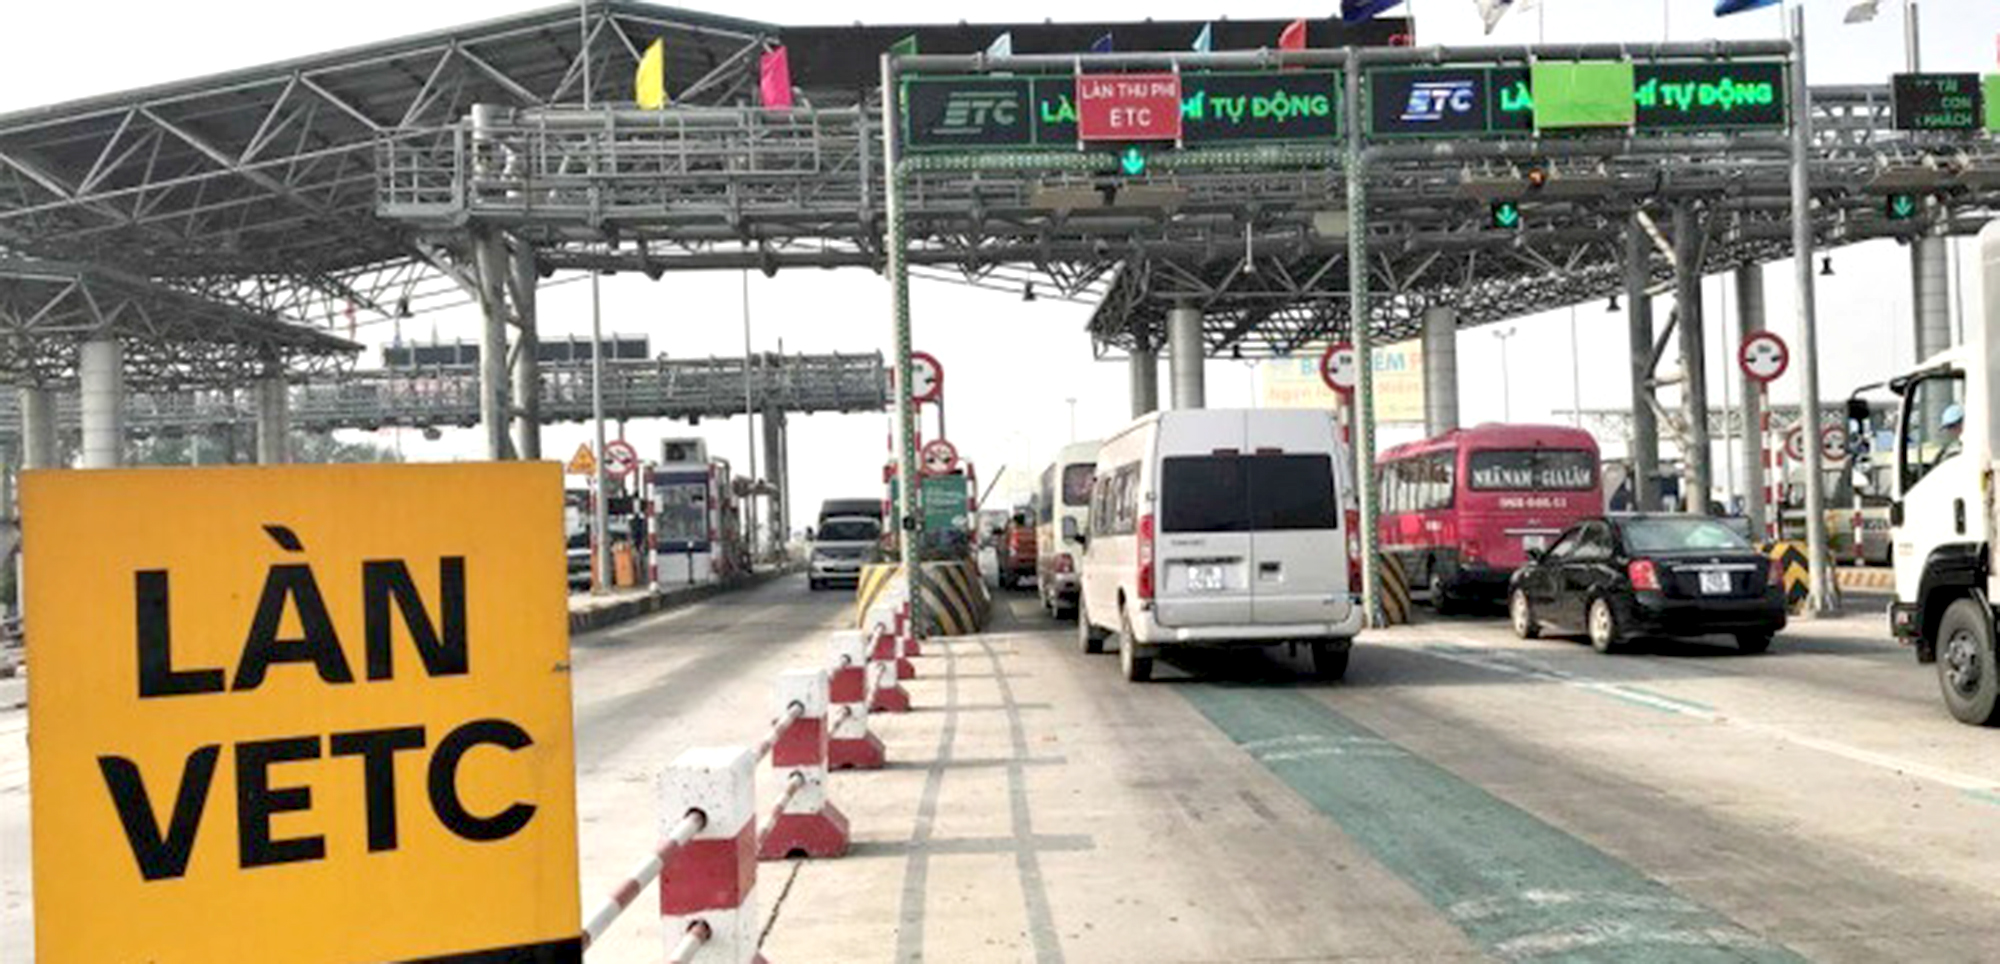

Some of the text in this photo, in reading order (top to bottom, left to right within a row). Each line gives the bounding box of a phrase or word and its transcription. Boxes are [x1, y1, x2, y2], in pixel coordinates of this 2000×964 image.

[1081, 80, 1114, 99] LÀN
[1116, 82, 1149, 99] THU
[1405, 88, 1474, 113] ETC
[1500, 81, 1534, 111] LÀ
[1697, 77, 1774, 111] ĐỘNG
[943, 99, 1019, 126] ETC
[1040, 93, 1078, 123] LÀ
[1251, 88, 1330, 123] ĐỘNG
[1109, 107, 1152, 128] ETC
[134, 524, 470, 699] LÀN
[97, 718, 538, 882] VETC
